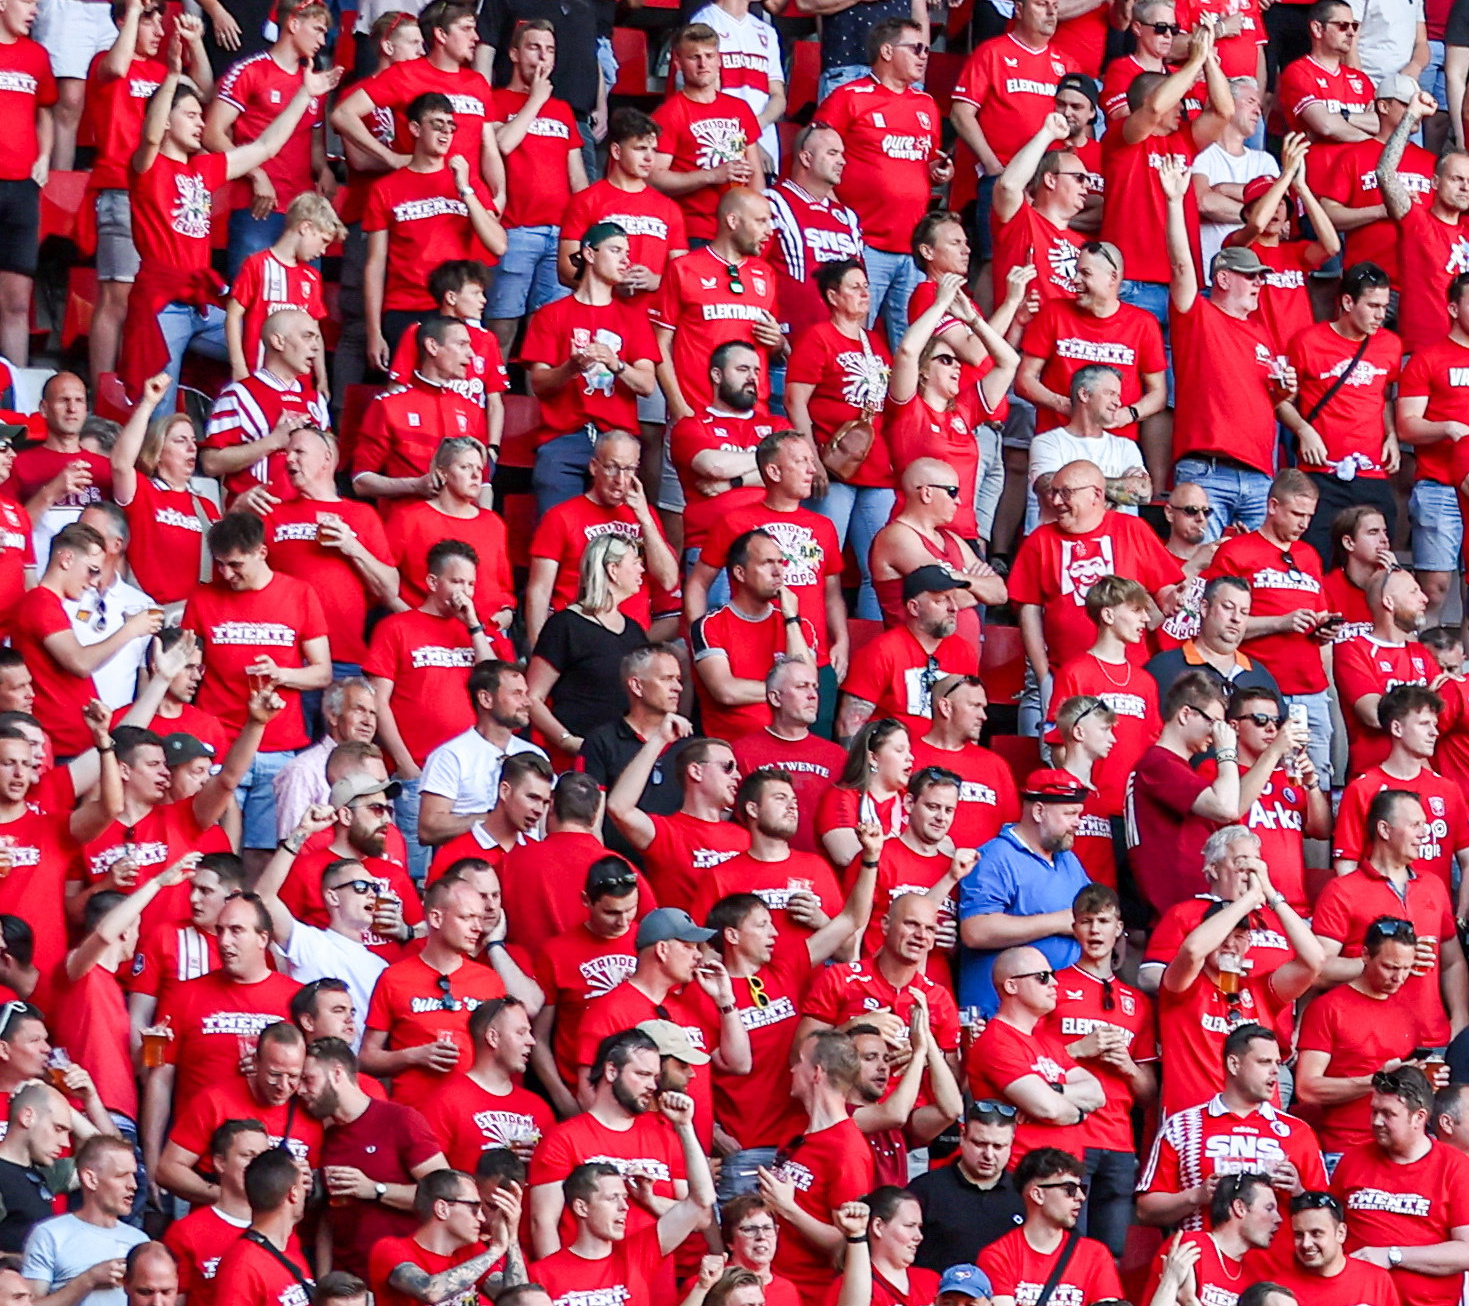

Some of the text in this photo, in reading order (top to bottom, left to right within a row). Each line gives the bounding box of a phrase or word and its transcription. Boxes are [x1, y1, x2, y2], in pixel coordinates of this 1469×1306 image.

[212, 624, 295, 639] TWENTE
[1249, 800, 1301, 830] Arke
[1205, 1135, 1284, 1159] SNS
